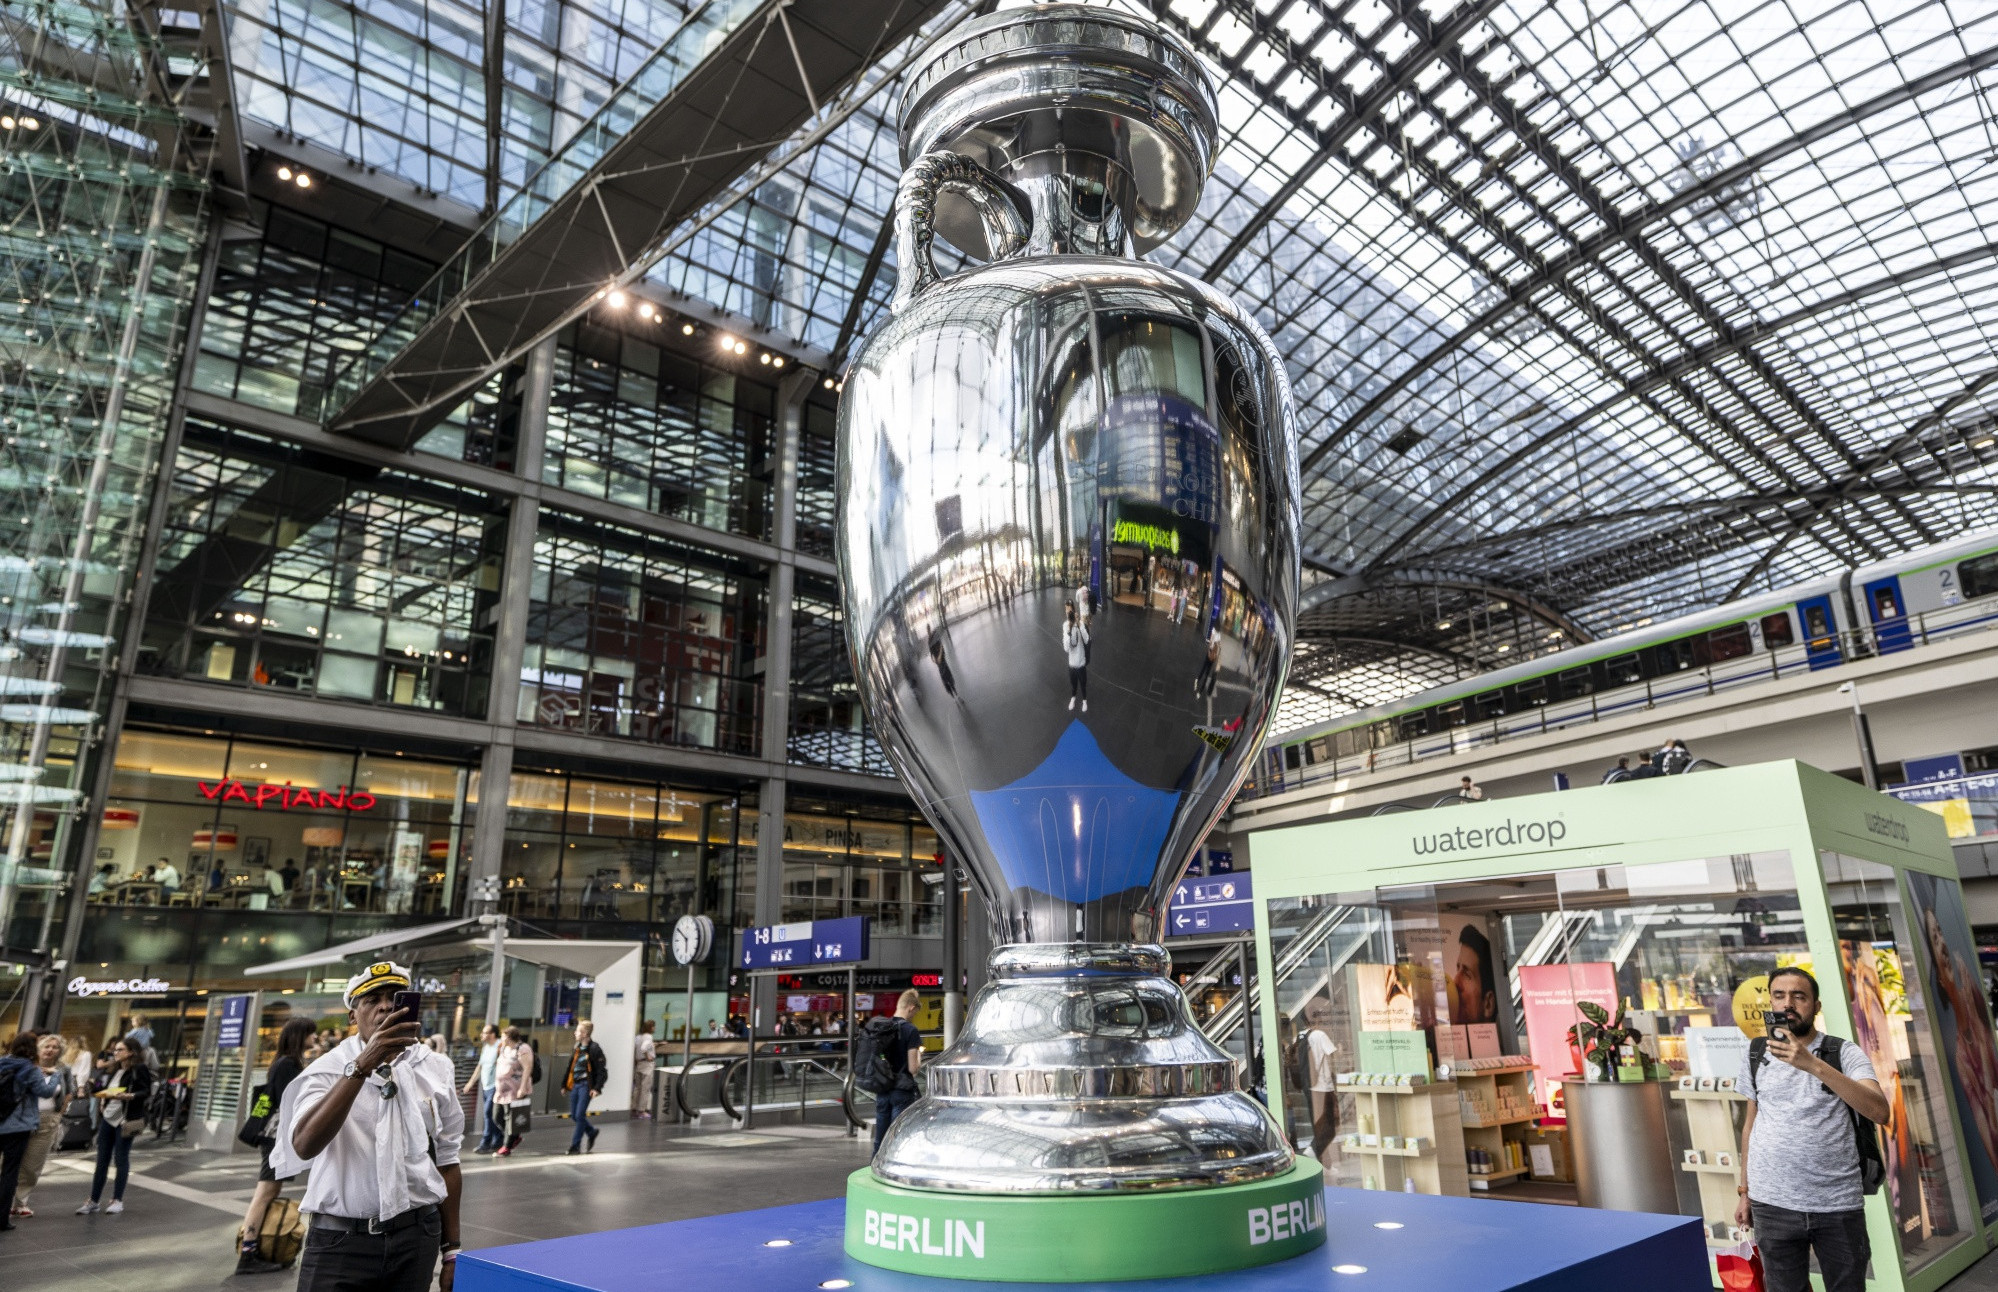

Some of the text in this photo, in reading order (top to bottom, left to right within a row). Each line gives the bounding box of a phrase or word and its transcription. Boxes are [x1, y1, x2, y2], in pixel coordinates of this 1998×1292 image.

[1938, 569, 1953, 588] 2
[1750, 622, 1761, 638] 2
[197, 776, 376, 811] VAPIANO
[825, 828, 863, 848] PINSA
[1413, 818, 1566, 855] waterdrop
[1864, 810, 1910, 847] waterdrop
[1196, 918, 1207, 927] WC
[754, 928, 770, 945] 1-8
[67, 976, 170, 997] Organic Coffee
[817, 975, 849, 986] COSTA
[912, 974, 939, 986] GOSCH
[662, 1084, 671, 1115] Abfall
[1248, 1189, 1325, 1246] BERLIN
[864, 1208, 985, 1259] BERLIN
